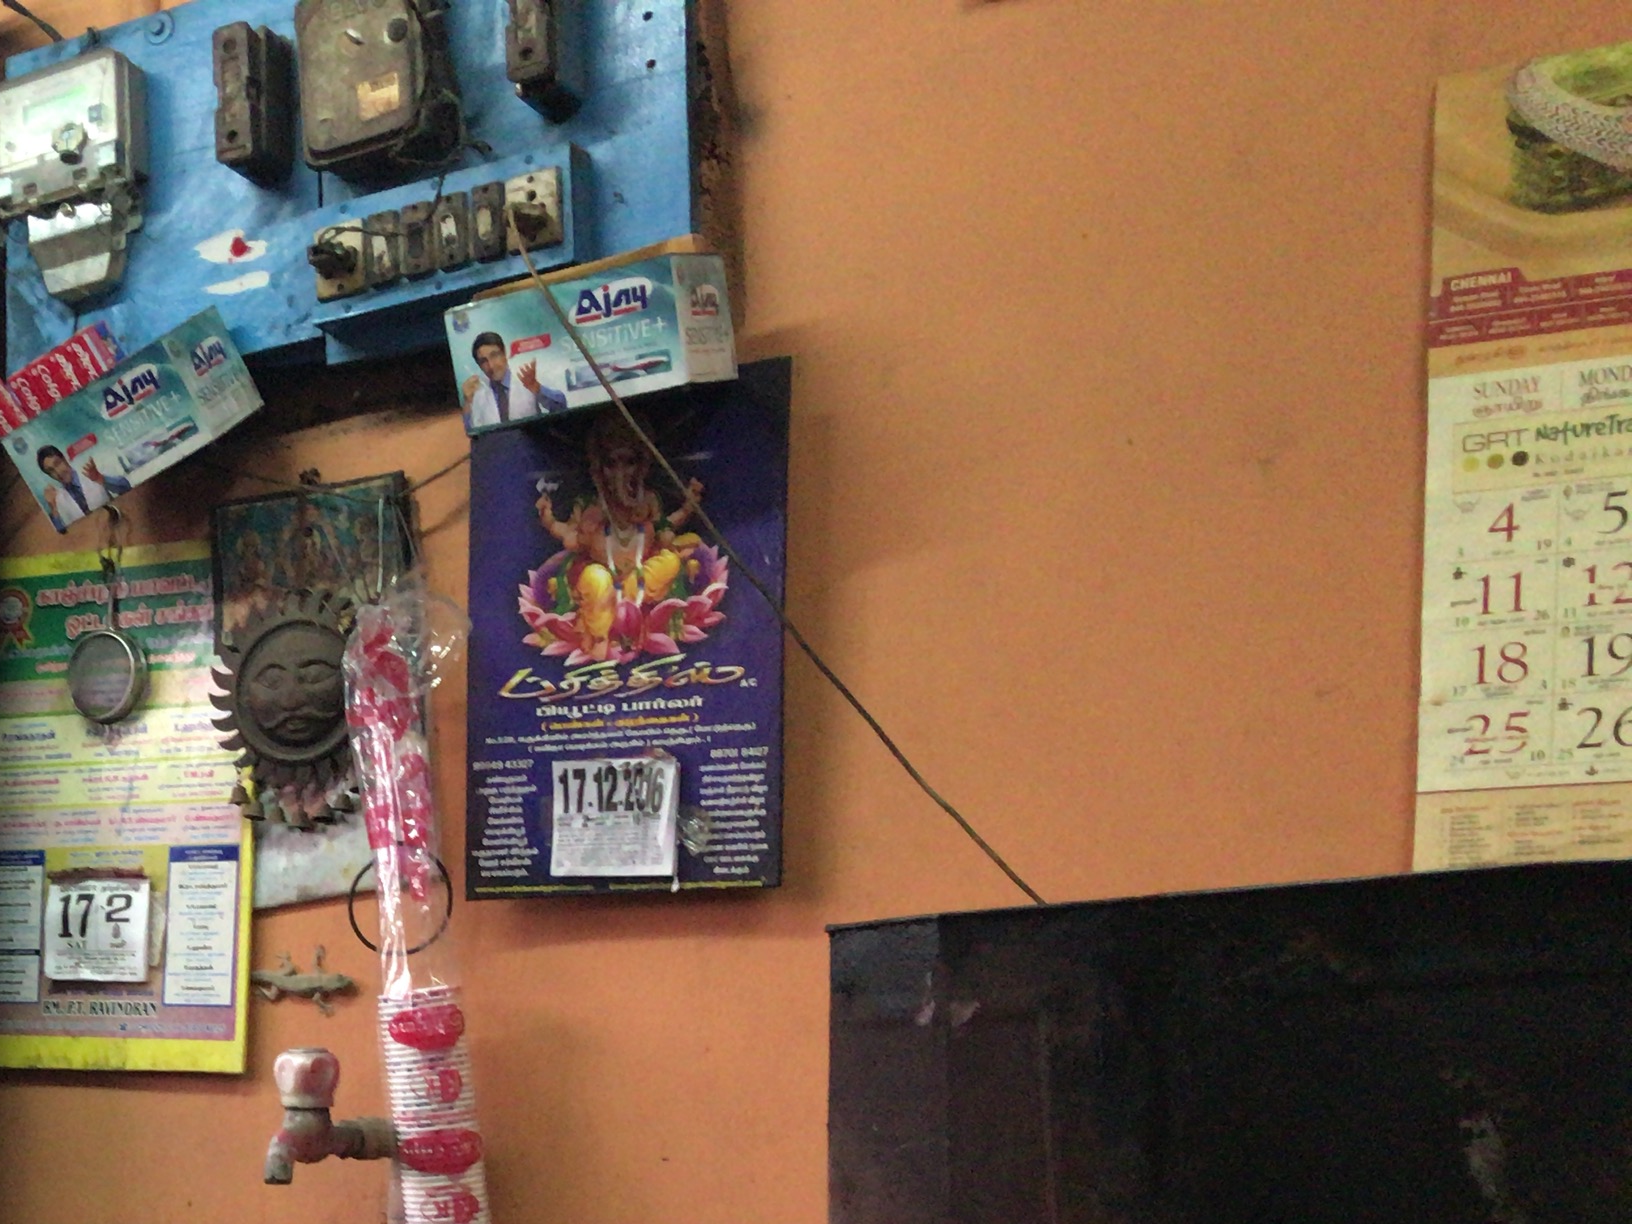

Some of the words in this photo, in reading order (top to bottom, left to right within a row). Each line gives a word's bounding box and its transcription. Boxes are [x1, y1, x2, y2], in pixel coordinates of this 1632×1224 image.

[575, 284, 648, 318] Ajay
[1450, 271, 1512, 291] CHENNAI
[102, 369, 161, 413] Ajay
[1473, 376, 1541, 400] SUNDAY
[1462, 428, 1530, 453] GRT
[1488, 503, 1520, 543] 4
[1597, 490, 1629, 535] 5
[1476, 571, 1526, 615] 11
[1471, 641, 1529, 685] 18
[1581, 633, 1632, 678] 19
[1463, 710, 1531, 757] 25
[1576, 705, 1632, 749] 26
[57, 893, 95, 939] 17
[105, 893, 133, 923] 2
[67, 940, 88, 949] SAT
